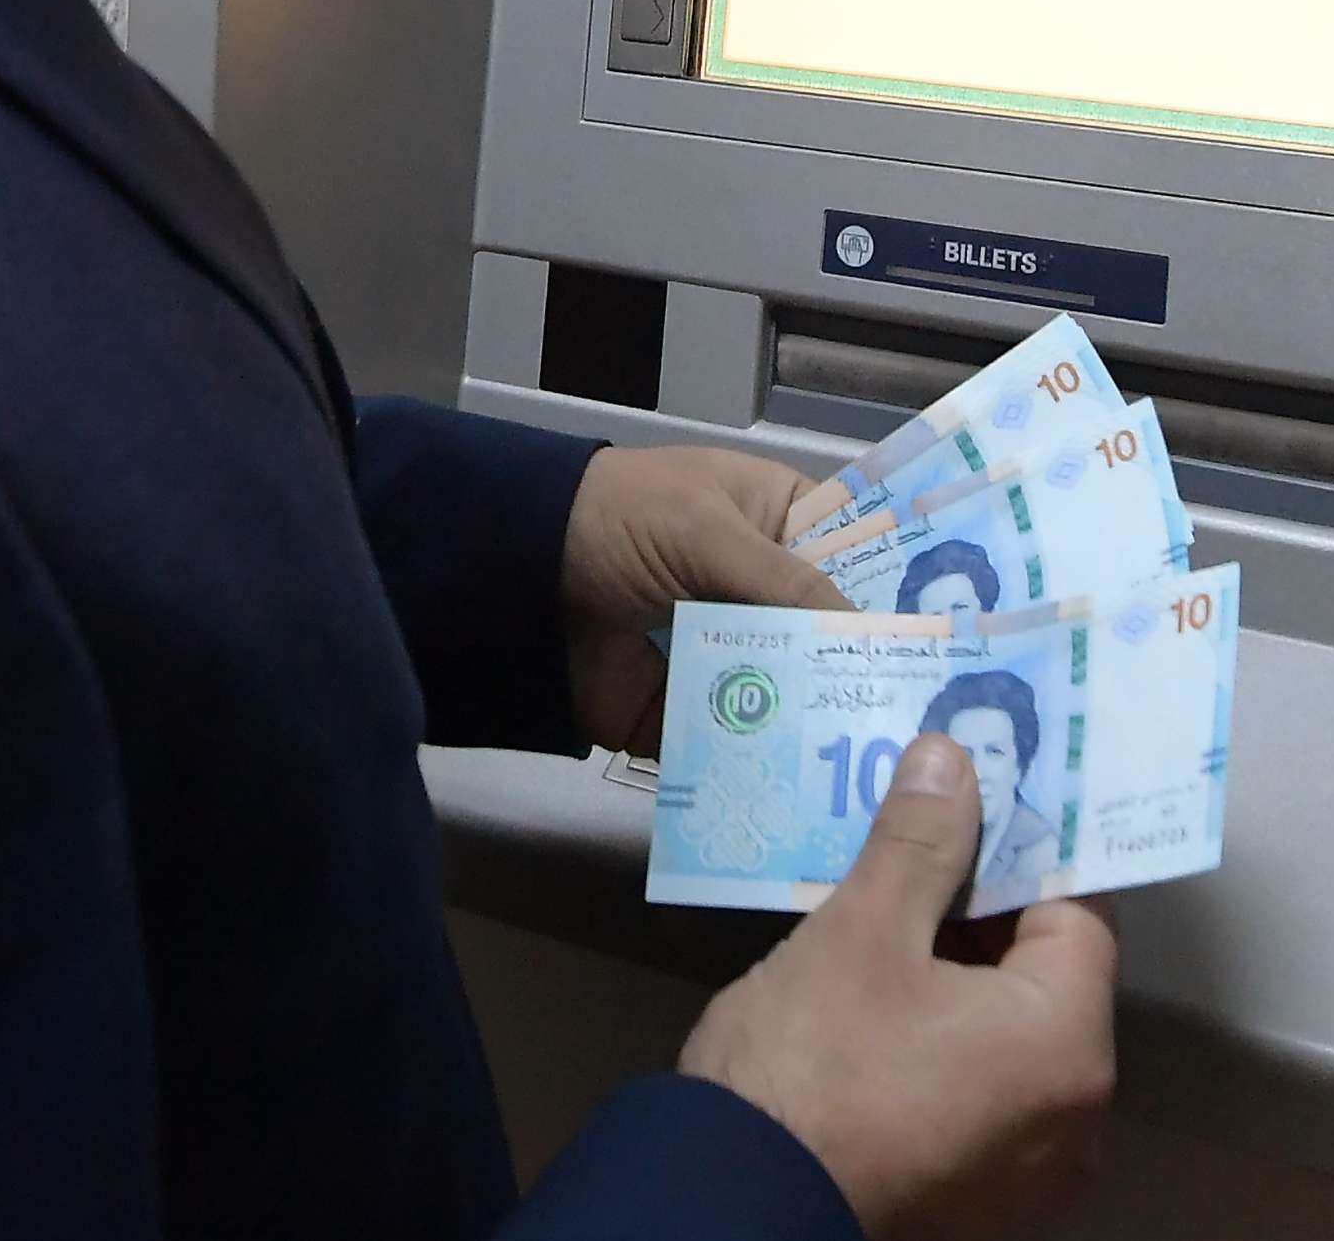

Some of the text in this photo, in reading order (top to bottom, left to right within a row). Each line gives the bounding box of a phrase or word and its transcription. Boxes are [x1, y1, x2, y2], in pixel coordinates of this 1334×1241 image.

[944, 241, 1037, 275] BILLETS
[1036, 361, 1080, 403] 10
[1095, 429, 1137, 469] 10
[1170, 591, 1212, 634] 10
